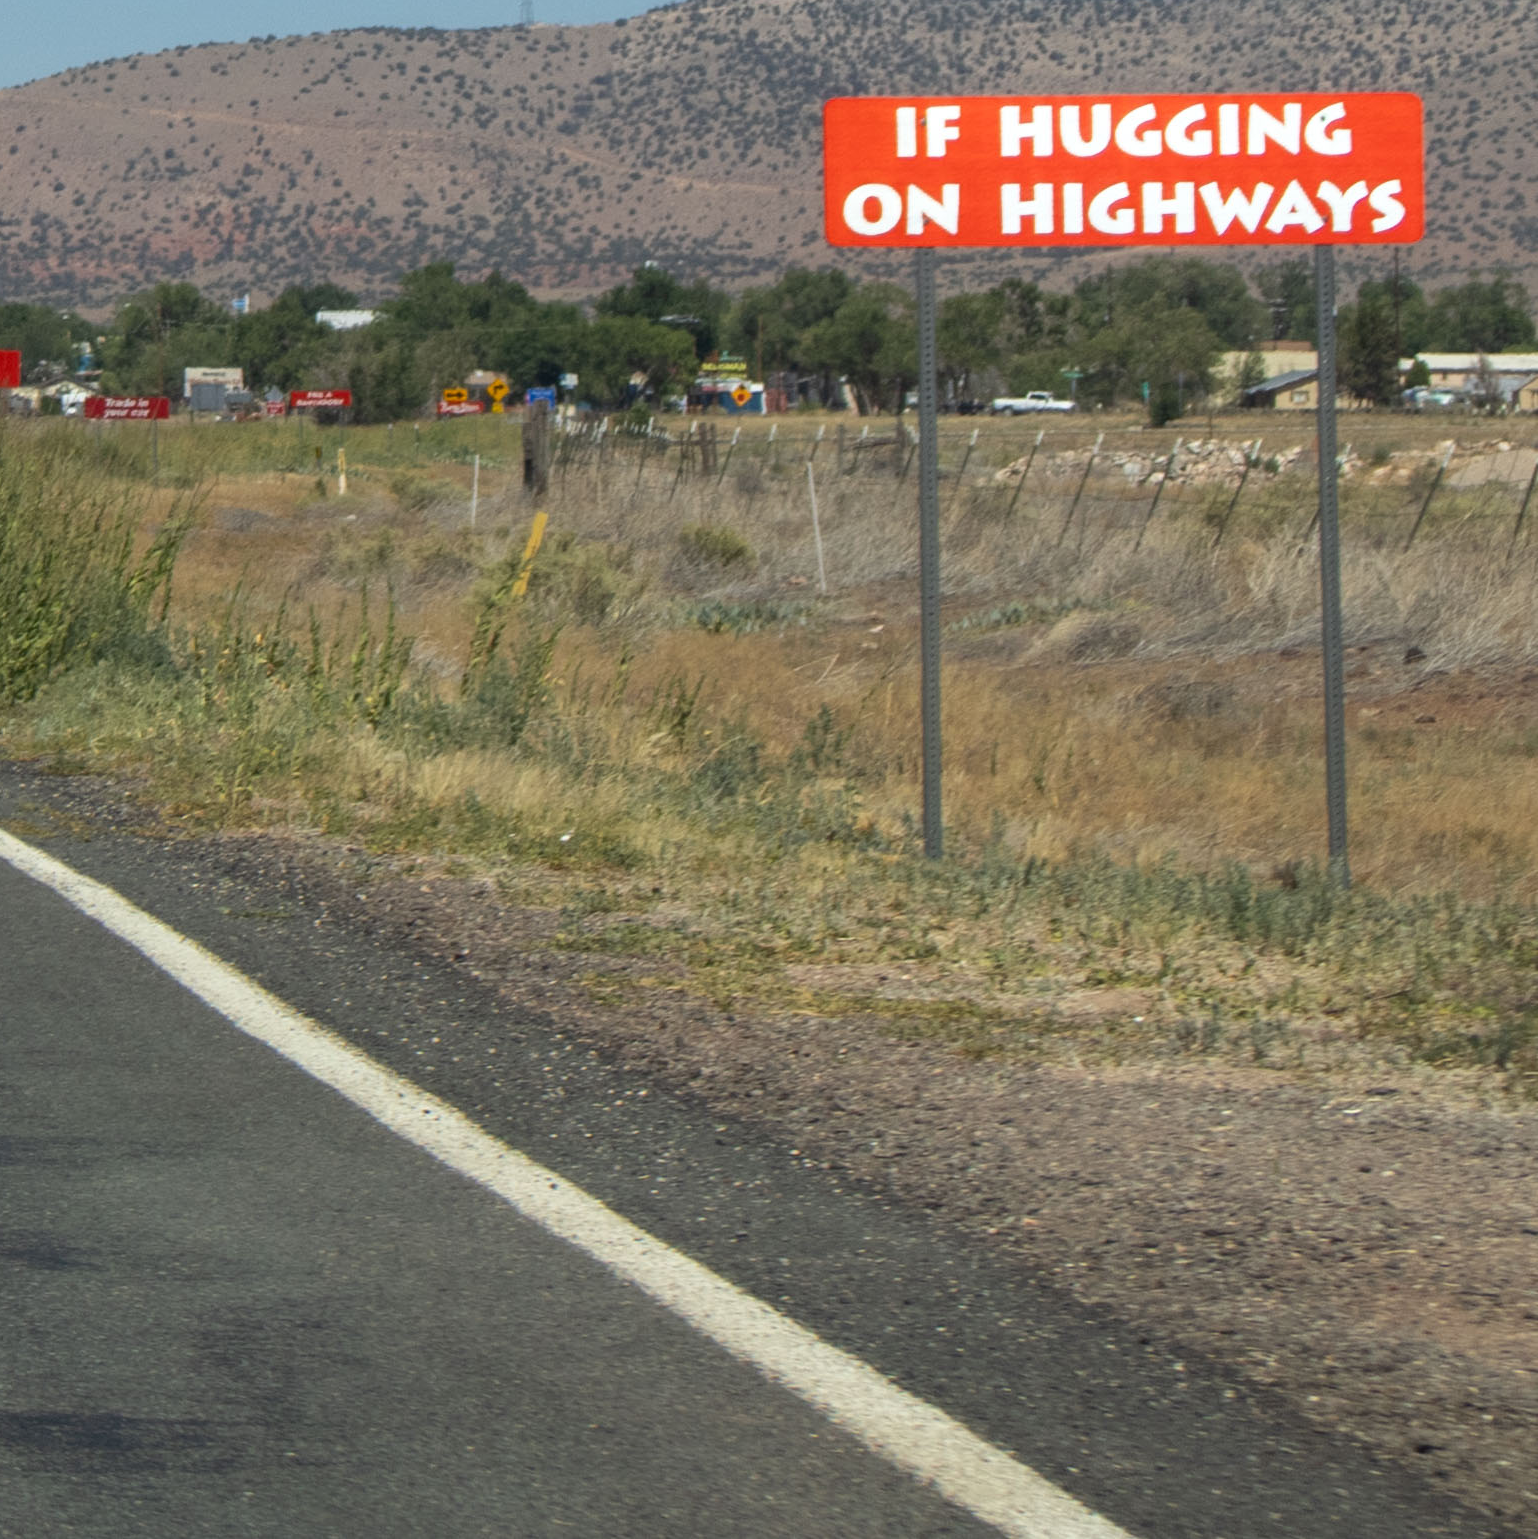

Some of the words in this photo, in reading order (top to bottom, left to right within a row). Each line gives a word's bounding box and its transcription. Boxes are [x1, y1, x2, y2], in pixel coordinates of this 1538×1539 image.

[895, 104, 961, 158] IF
[1000, 101, 1354, 157] HUGGING
[842, 182, 961, 237] ON
[1000, 178, 1407, 236] HIGHWAYS
